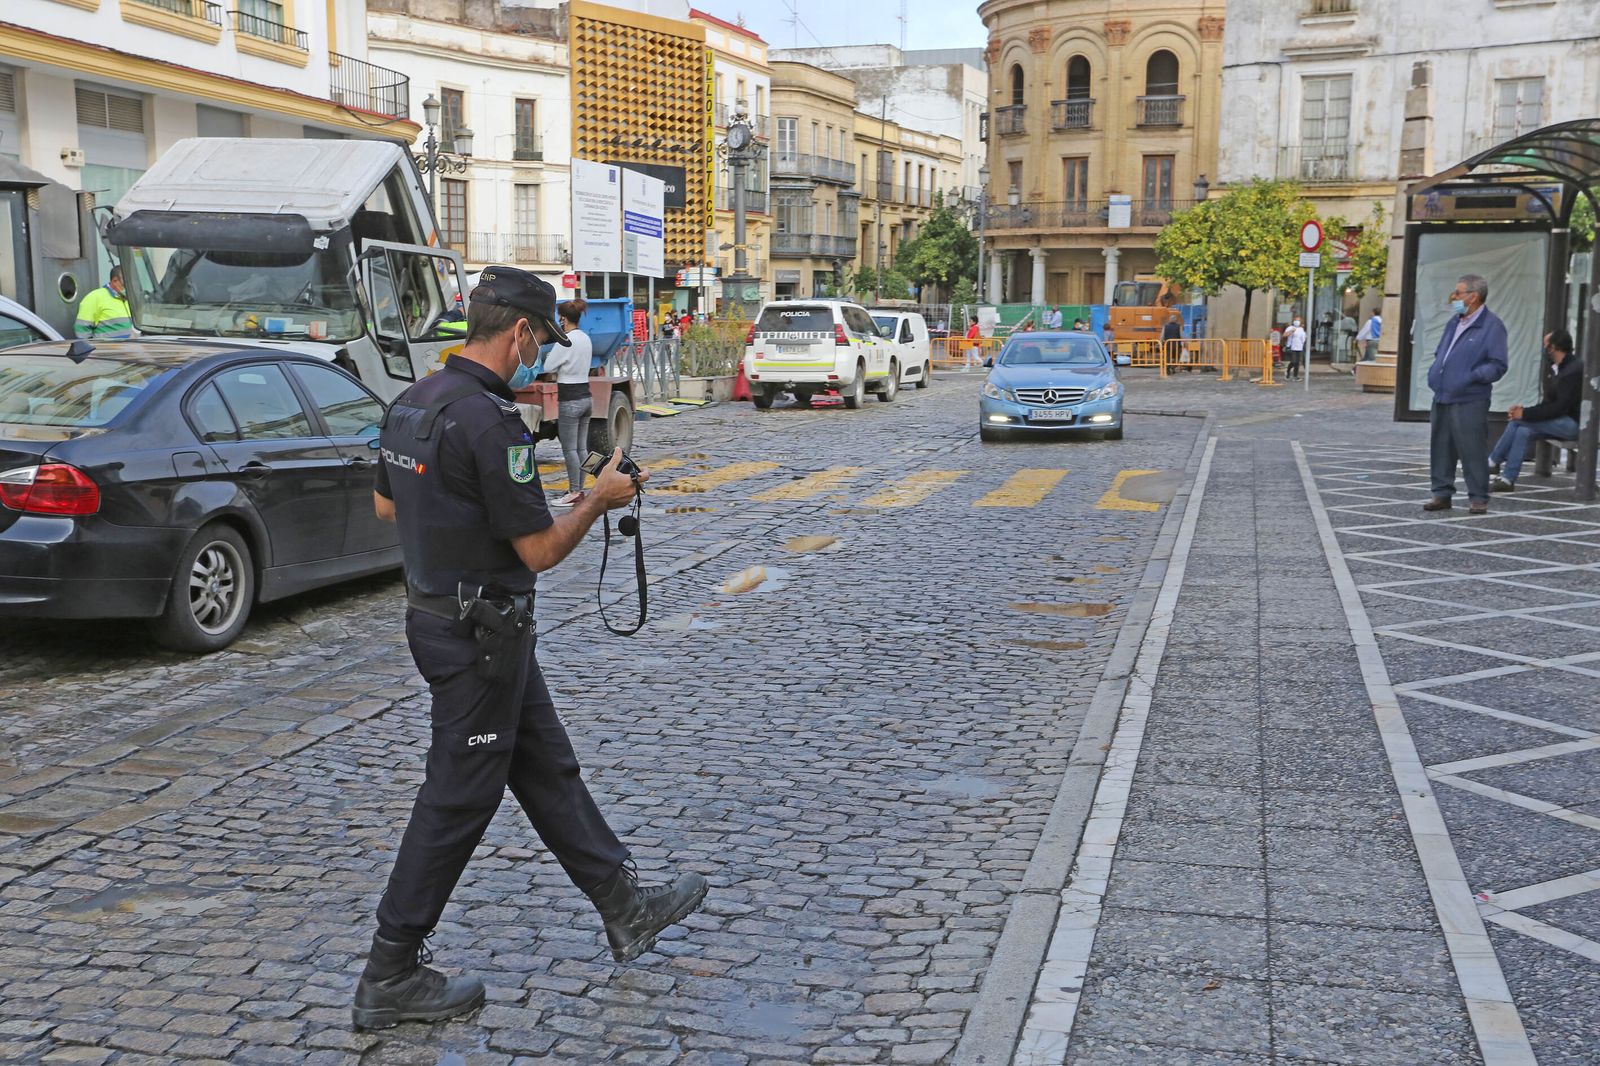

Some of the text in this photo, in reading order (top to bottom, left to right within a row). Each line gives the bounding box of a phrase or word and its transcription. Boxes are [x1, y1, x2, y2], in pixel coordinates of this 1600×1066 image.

[705, 52, 713, 227] ULLOA OPTICO
[480, 273, 497, 282] CNP
[380, 447, 417, 471] POLICIA
[467, 733, 498, 746] CNP
